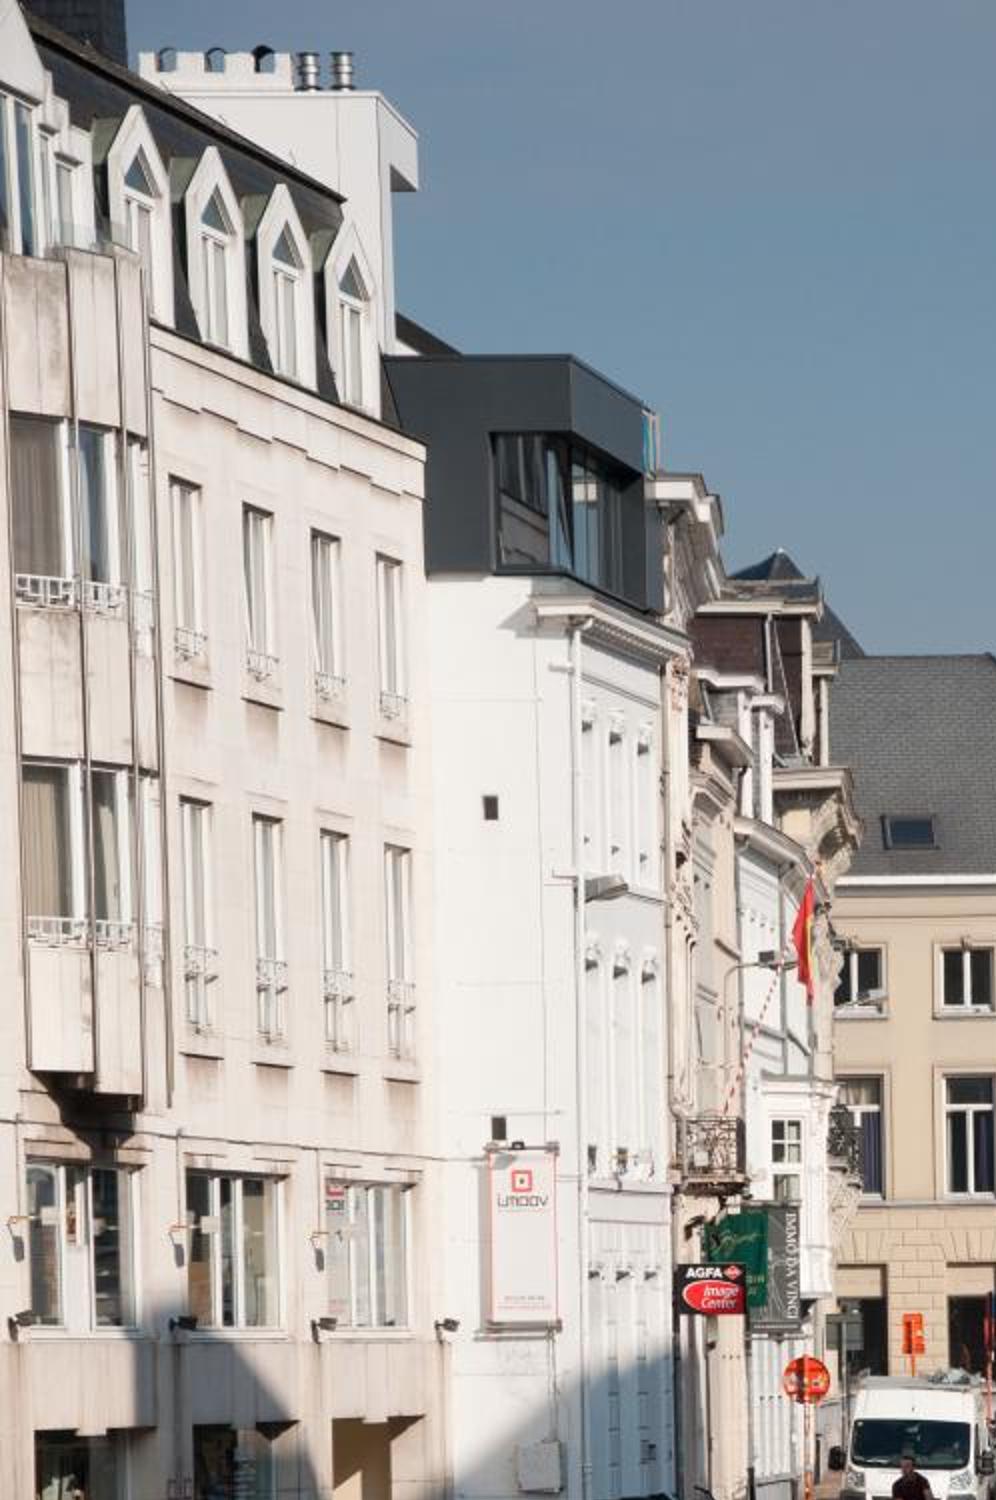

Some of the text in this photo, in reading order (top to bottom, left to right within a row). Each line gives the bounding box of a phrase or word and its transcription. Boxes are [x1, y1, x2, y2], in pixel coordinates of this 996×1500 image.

[785, 1212, 799, 1319] IMMO DA VINCI
[685, 1267, 723, 1279] AGFA
[703, 1285, 739, 1299] Image
[701, 1298, 738, 1309] Center
